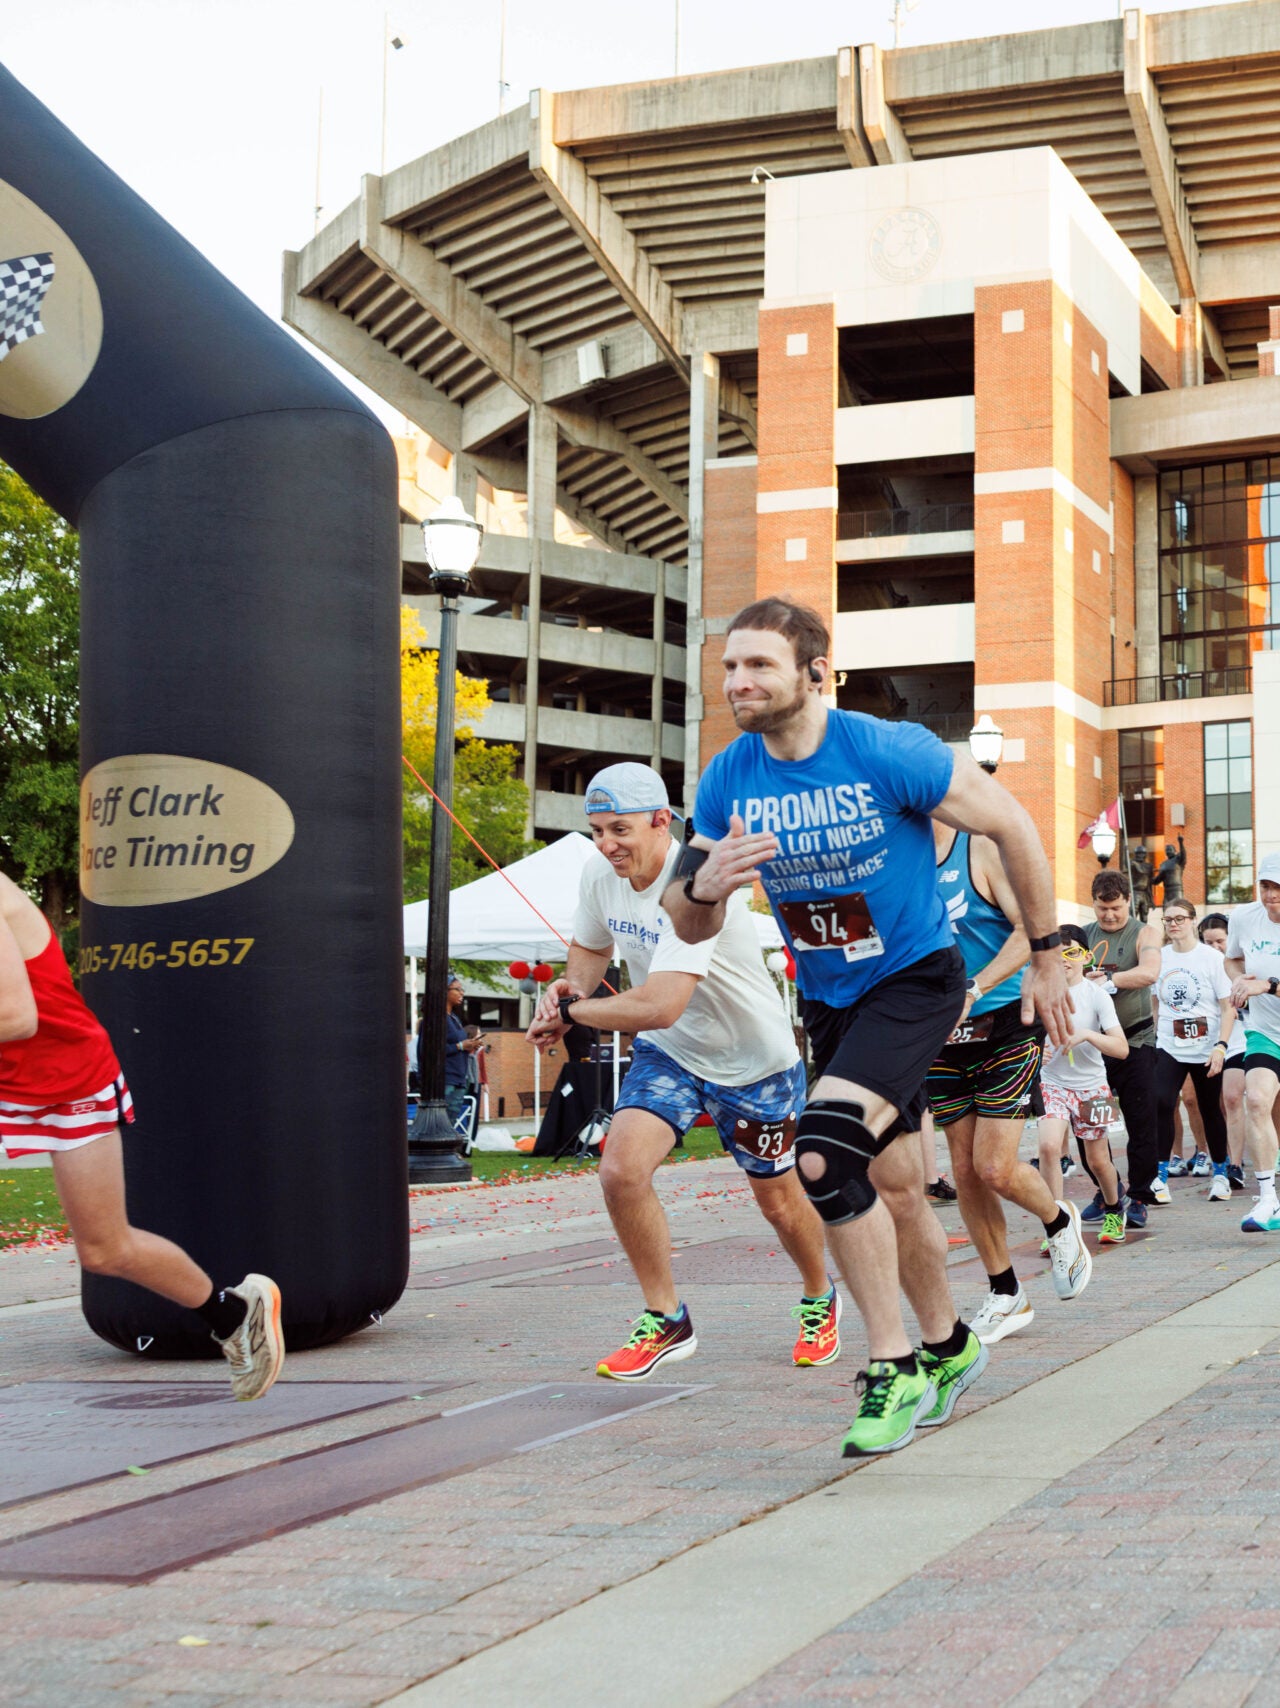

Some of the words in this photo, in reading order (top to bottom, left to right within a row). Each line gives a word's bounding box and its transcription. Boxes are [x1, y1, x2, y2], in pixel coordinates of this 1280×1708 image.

[86, 786, 124, 827] Jeff
[128, 784, 224, 818] Clark
[745, 783, 880, 835] PROMISE
[787, 830, 822, 856] LOT
[825, 817, 885, 851] NICER
[126, 835, 255, 874] Timing
[766, 855, 819, 877] THAN
[821, 850, 851, 870] MY
[813, 870, 846, 889] GYM
[810, 912, 848, 943] 94
[1173, 990, 1187, 1000] 5K
[1184, 1023, 1198, 1037] 50
[1090, 1105, 1114, 1124] 472
[757, 1131, 784, 1156] 93
